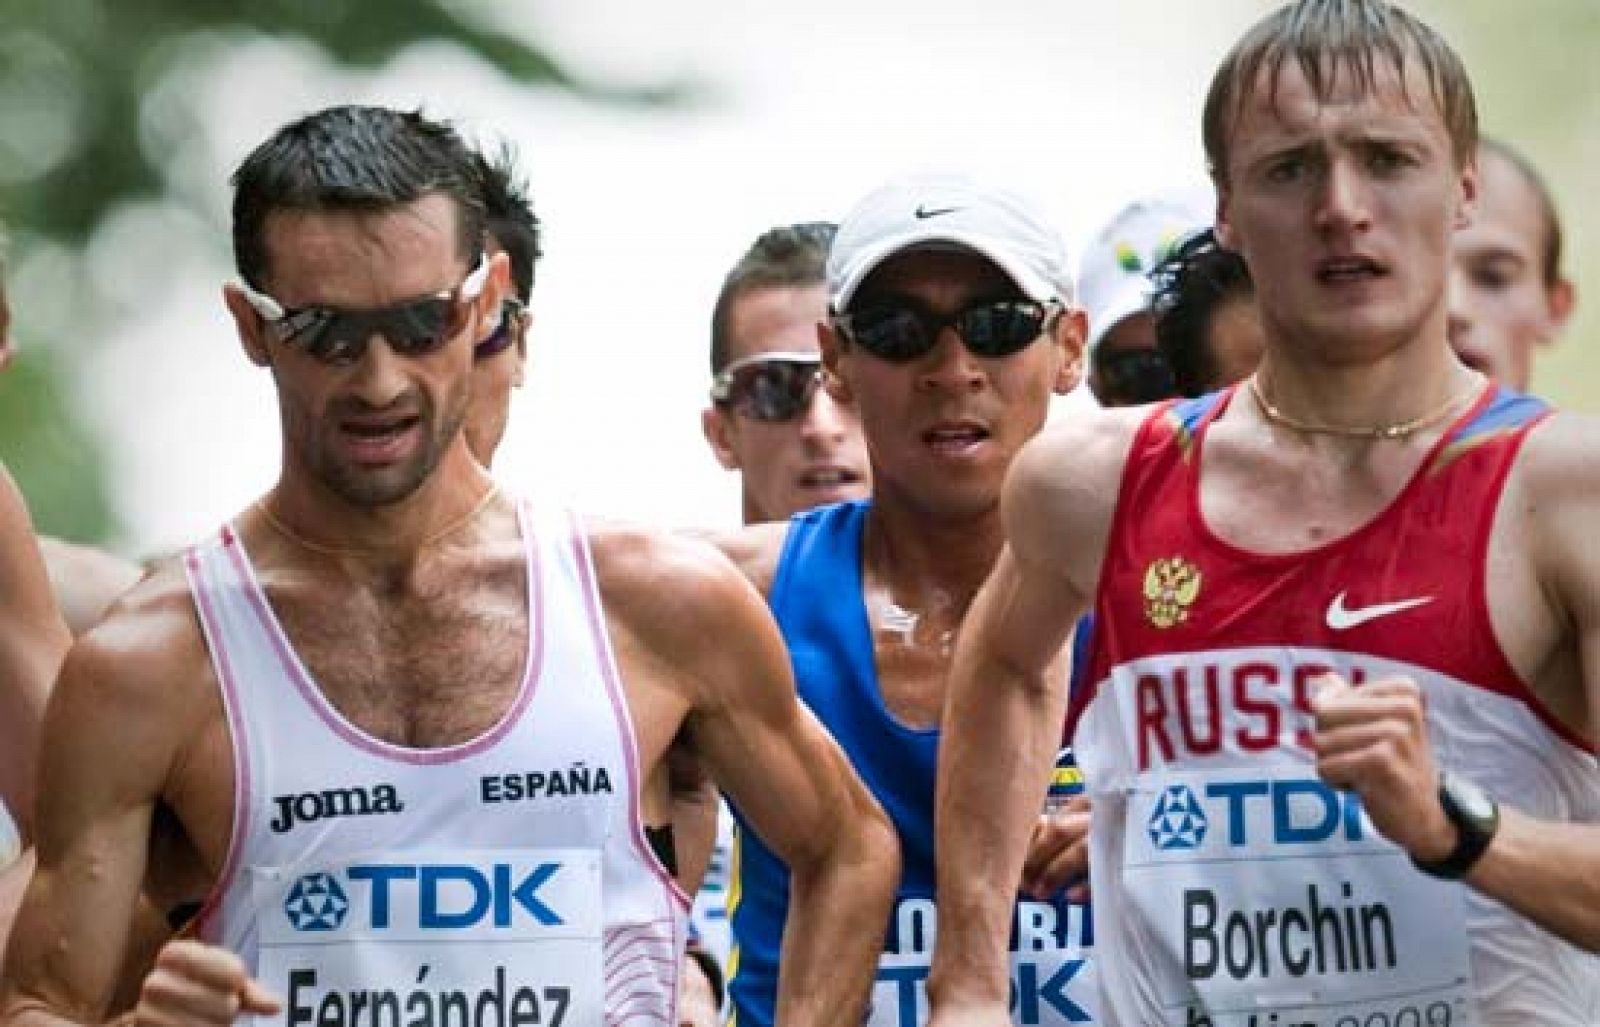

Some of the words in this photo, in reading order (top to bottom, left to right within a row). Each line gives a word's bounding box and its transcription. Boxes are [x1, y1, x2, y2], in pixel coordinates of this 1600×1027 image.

[1136, 660, 1367, 775] RUSS
[480, 761, 613, 803] ESPAÑA
[347, 863, 566, 930] TDK
[1183, 881, 1398, 980] Borchin
[286, 965, 571, 1027] Fernández
[874, 958, 1093, 1027] TK
